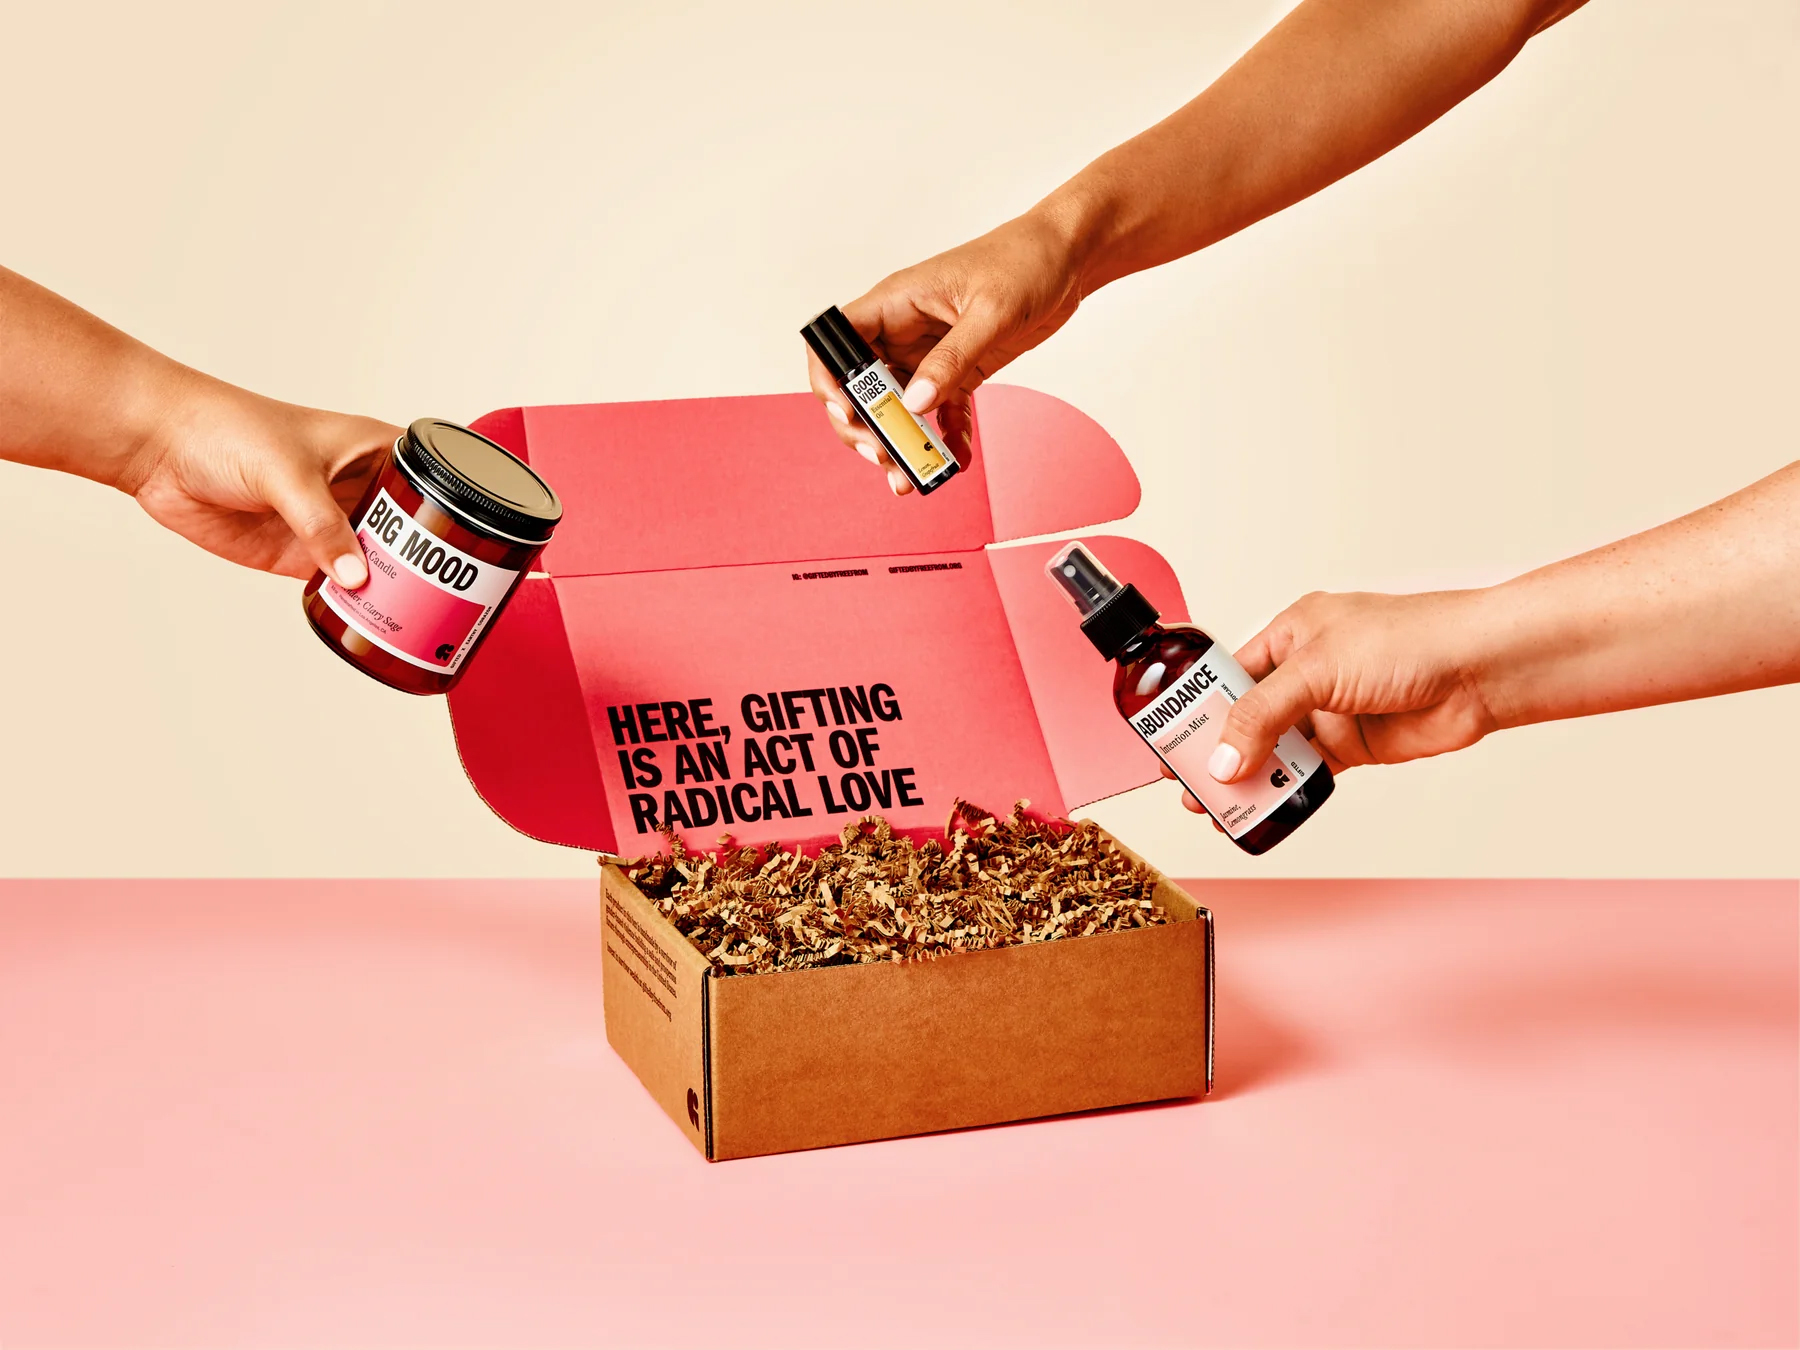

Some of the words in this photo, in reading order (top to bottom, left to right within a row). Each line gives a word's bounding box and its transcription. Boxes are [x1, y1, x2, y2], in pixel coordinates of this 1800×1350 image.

[852, 370, 879, 395] GOOD
[858, 380, 887, 404] VIBES
[870, 395, 893, 413] Essential
[875, 411, 884, 421] Oil
[366, 496, 404, 547] BIG
[399, 529, 479, 592] MOOD
[369, 550, 397, 579] Candle
[803, 568, 869, 580] @GIFTEDBYFREEFROM
[888, 562, 963, 574] GIFTEDBYFREEFROM.ORG
[363, 601, 384, 620] Clary
[383, 616, 403, 632] Sage
[1136, 663, 1219, 739] ABUNDANCE
[606, 697, 732, 746] HERE,
[740, 682, 903, 733] GIFTING
[1159, 731, 1190, 755] Intention
[1189, 712, 1210, 737] Mist
[617, 747, 662, 790] IS
[675, 741, 731, 784] AN
[744, 733, 816, 778] ACT
[828, 727, 880, 769] OF
[1290, 761, 1305, 777] GIFTED
[628, 778, 813, 834] RADICAL
[818, 767, 924, 815] LOVE
[1220, 803, 1242, 822] Jasmine,
[1227, 803, 1257, 828] Lemongrass
